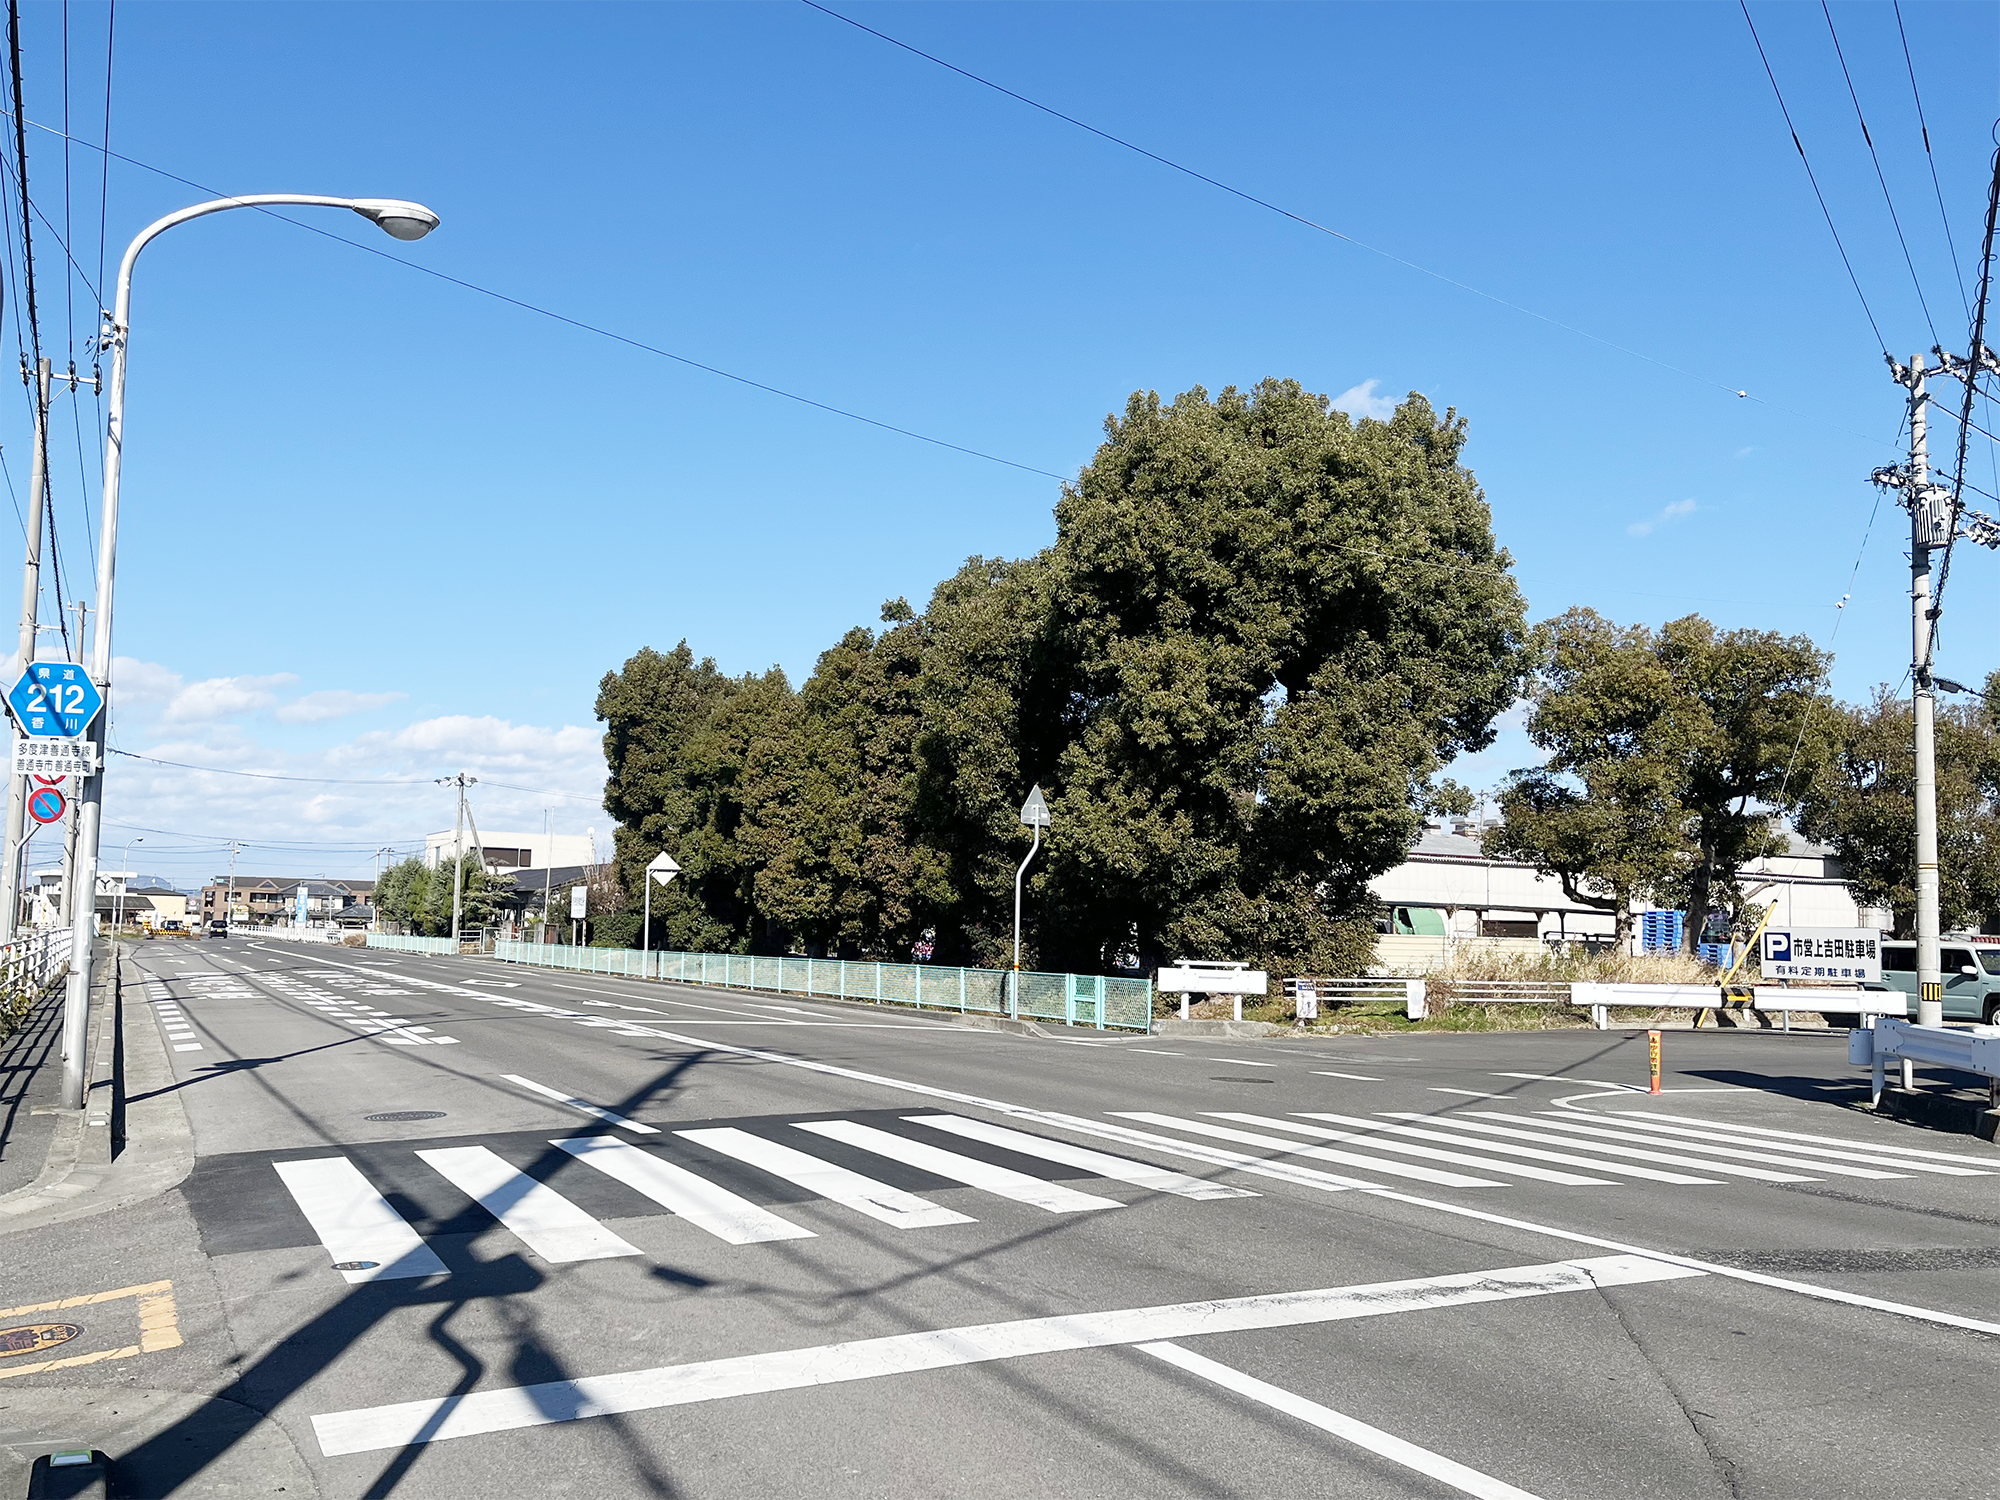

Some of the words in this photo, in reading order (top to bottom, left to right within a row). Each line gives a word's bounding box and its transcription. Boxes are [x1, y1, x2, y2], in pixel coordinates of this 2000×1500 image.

[38, 667, 75, 680] 県道
[26, 683, 85, 714] 212
[31, 717, 78, 730] 香川
[18, 743, 91, 757] 多度津善通寺線
[17, 758, 91, 773] 善通寺市善通寺町
[1766, 934, 1789, 959] P
[1793, 938, 1876, 959] 市営上吉田駐車場
[1775, 965, 1866, 978] 有料定期駐車場
